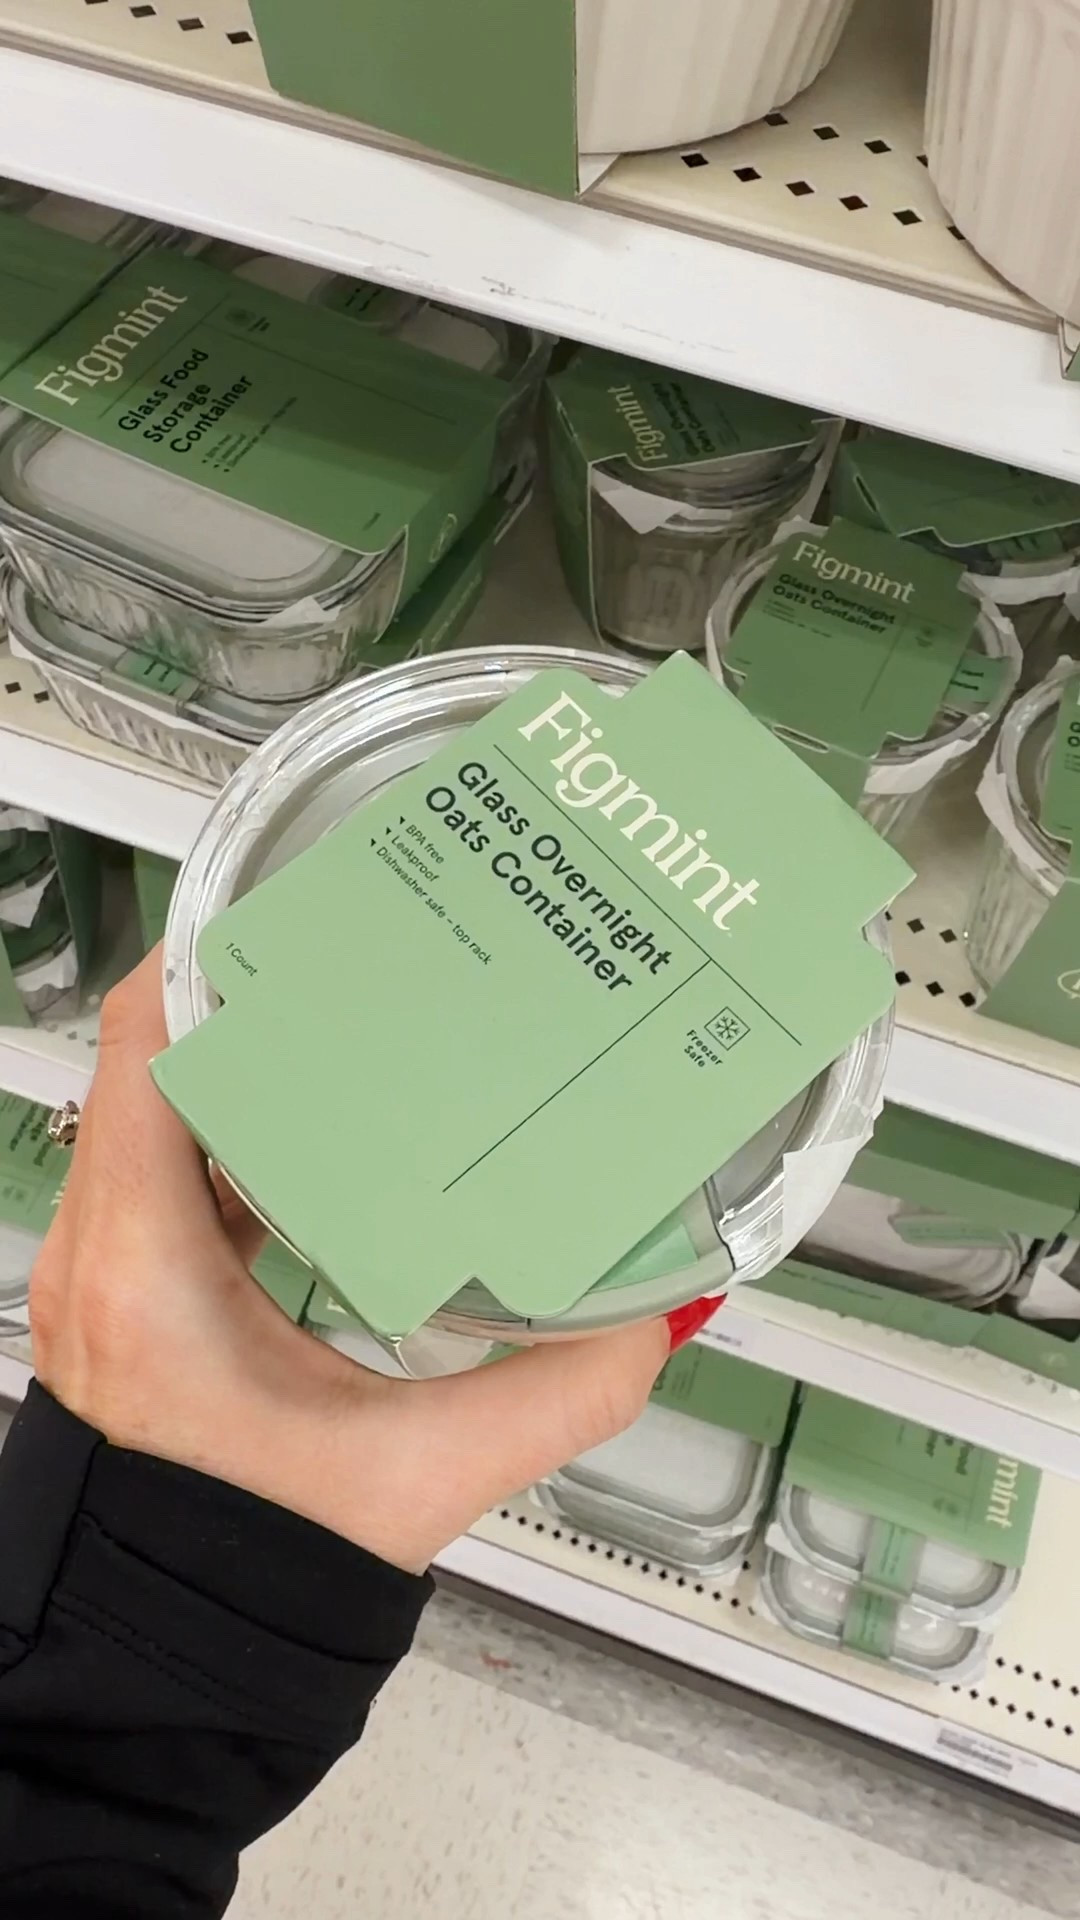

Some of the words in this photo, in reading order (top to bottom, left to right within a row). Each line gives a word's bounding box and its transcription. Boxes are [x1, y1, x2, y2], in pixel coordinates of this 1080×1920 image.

[33, 283, 188, 407] Figmint
[117, 390, 169, 431] Glass
[159, 348, 209, 389] Food
[143, 384, 212, 443] Storage
[170, 375, 253, 453] Container
[607, 384, 668, 461] Figmint
[778, 573, 817, 595] Glass
[821, 589, 896, 625] Overnight
[792, 540, 916, 604] Figmint
[772, 584, 807, 605] Oats
[811, 599, 886, 634] Container
[405, 824, 427, 846] BPA
[423, 842, 445, 865] free
[517, 690, 761, 931] Figmint
[391, 835, 440, 883] Leakproof
[425, 786, 491, 853] Oats
[490, 851, 633, 992] Container
[457, 762, 530, 836] Glass
[531, 834, 672, 975] Overnight
[376, 846, 428, 898] Dishwasher
[425, 897, 447, 919] safe
[451, 923, 471, 944] top
[468, 941, 492, 965] rack
[231, 948, 258, 977] Count
[684, 1045, 706, 1067] Safe
[686, 1029, 723, 1065] Freezer
[985, 1457, 1019, 1529] mint
